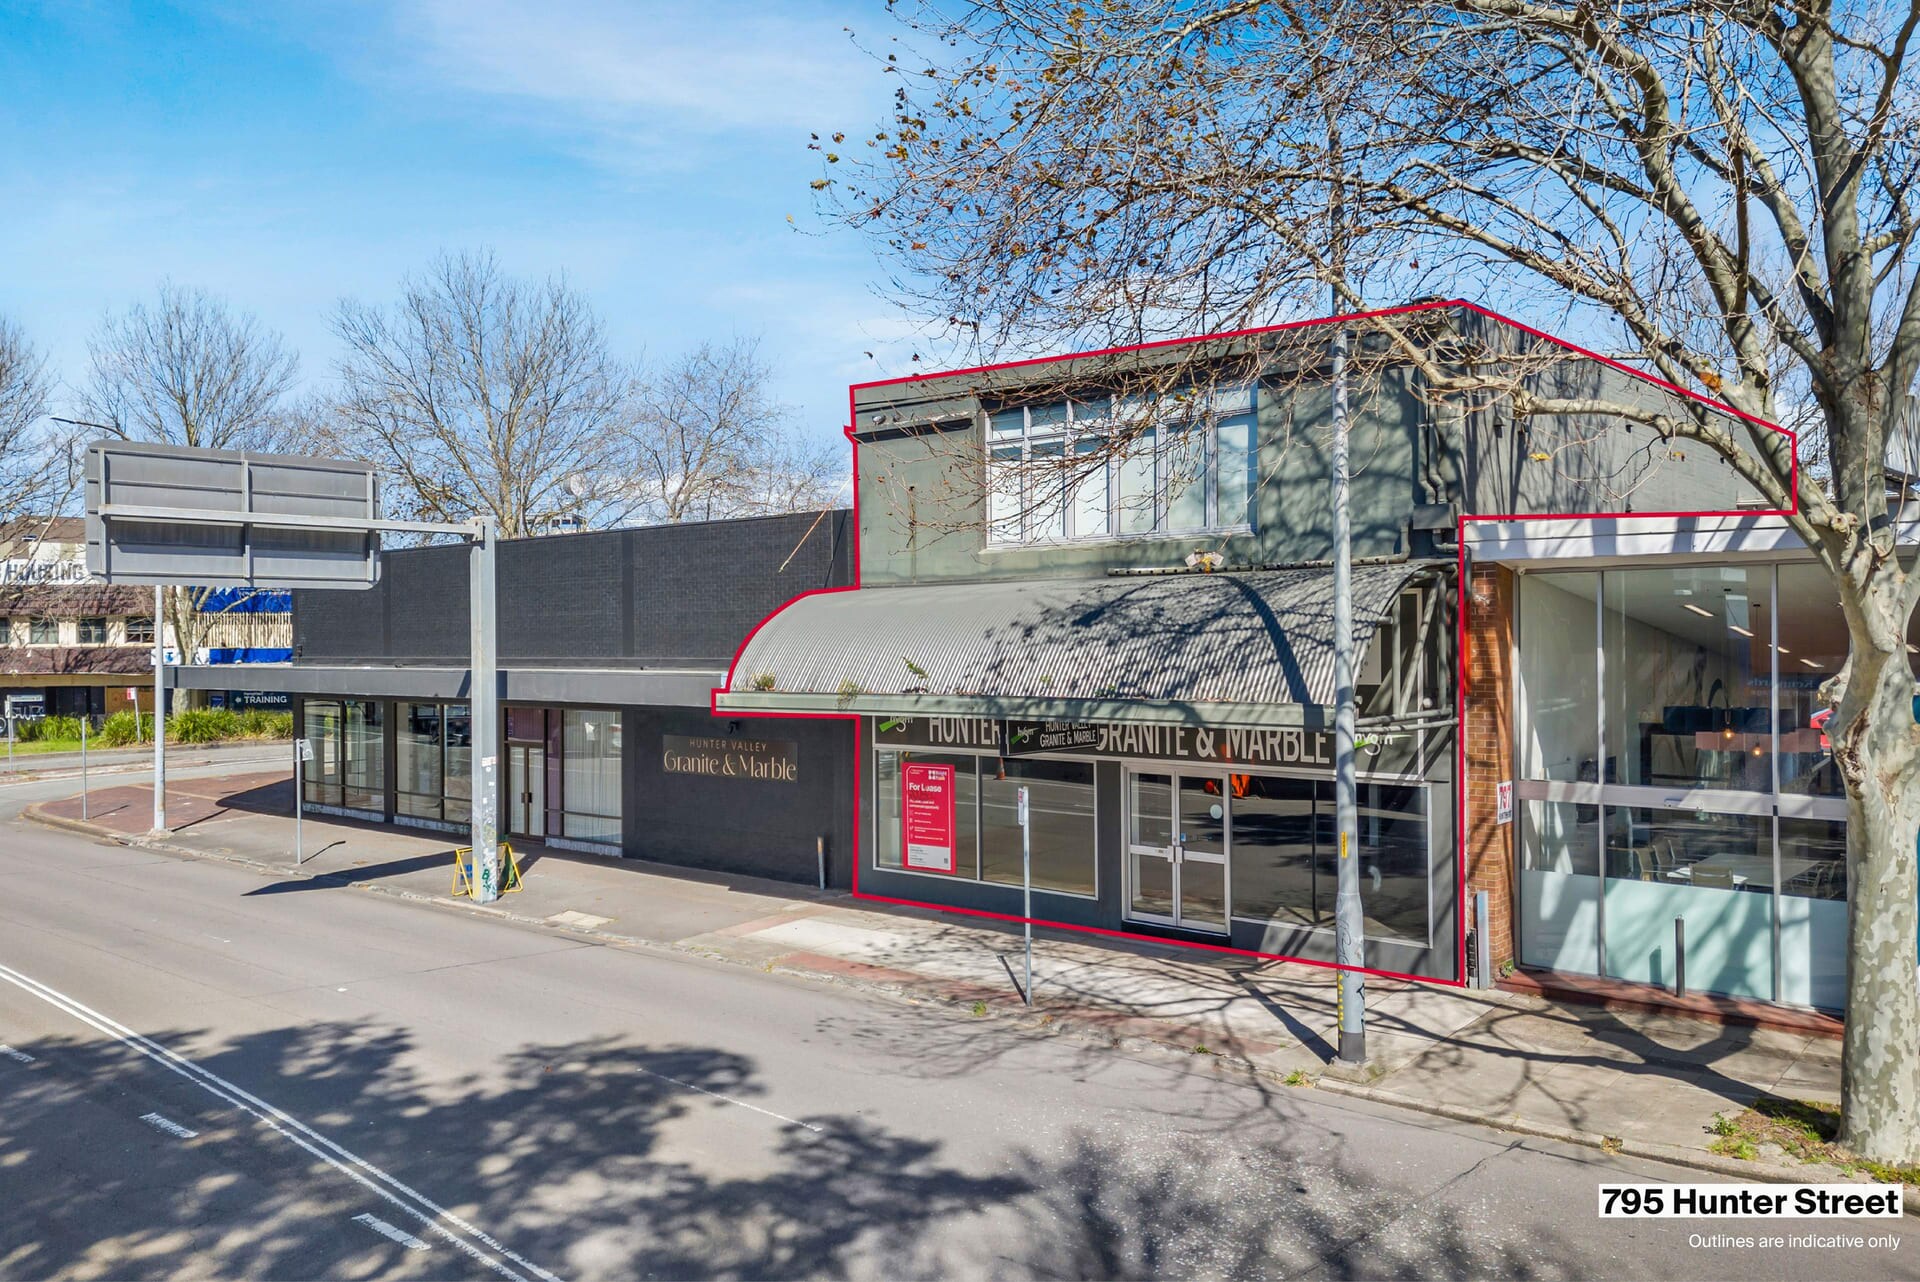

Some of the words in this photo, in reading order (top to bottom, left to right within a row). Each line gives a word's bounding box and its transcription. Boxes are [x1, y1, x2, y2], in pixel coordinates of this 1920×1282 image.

[244, 695, 287, 704] TRAINING
[929, 717, 1001, 746] HUNTER
[1045, 720, 1069, 732] HUNTER
[689, 739, 727, 750] HUNTER
[731, 741, 767, 752] VALLEY
[1040, 733, 1066, 748] GRANITE
[1067, 731, 1073, 745] &
[1074, 729, 1096, 744] MARBLE
[1196, 727, 1217, 759] &
[1226, 728, 1330, 764] MARBLE
[663, 749, 719, 775] Granite
[722, 753, 736, 776] &
[740, 754, 796, 780] Marble
[909, 782, 920, 791] For
[921, 783, 942, 793] Lease
